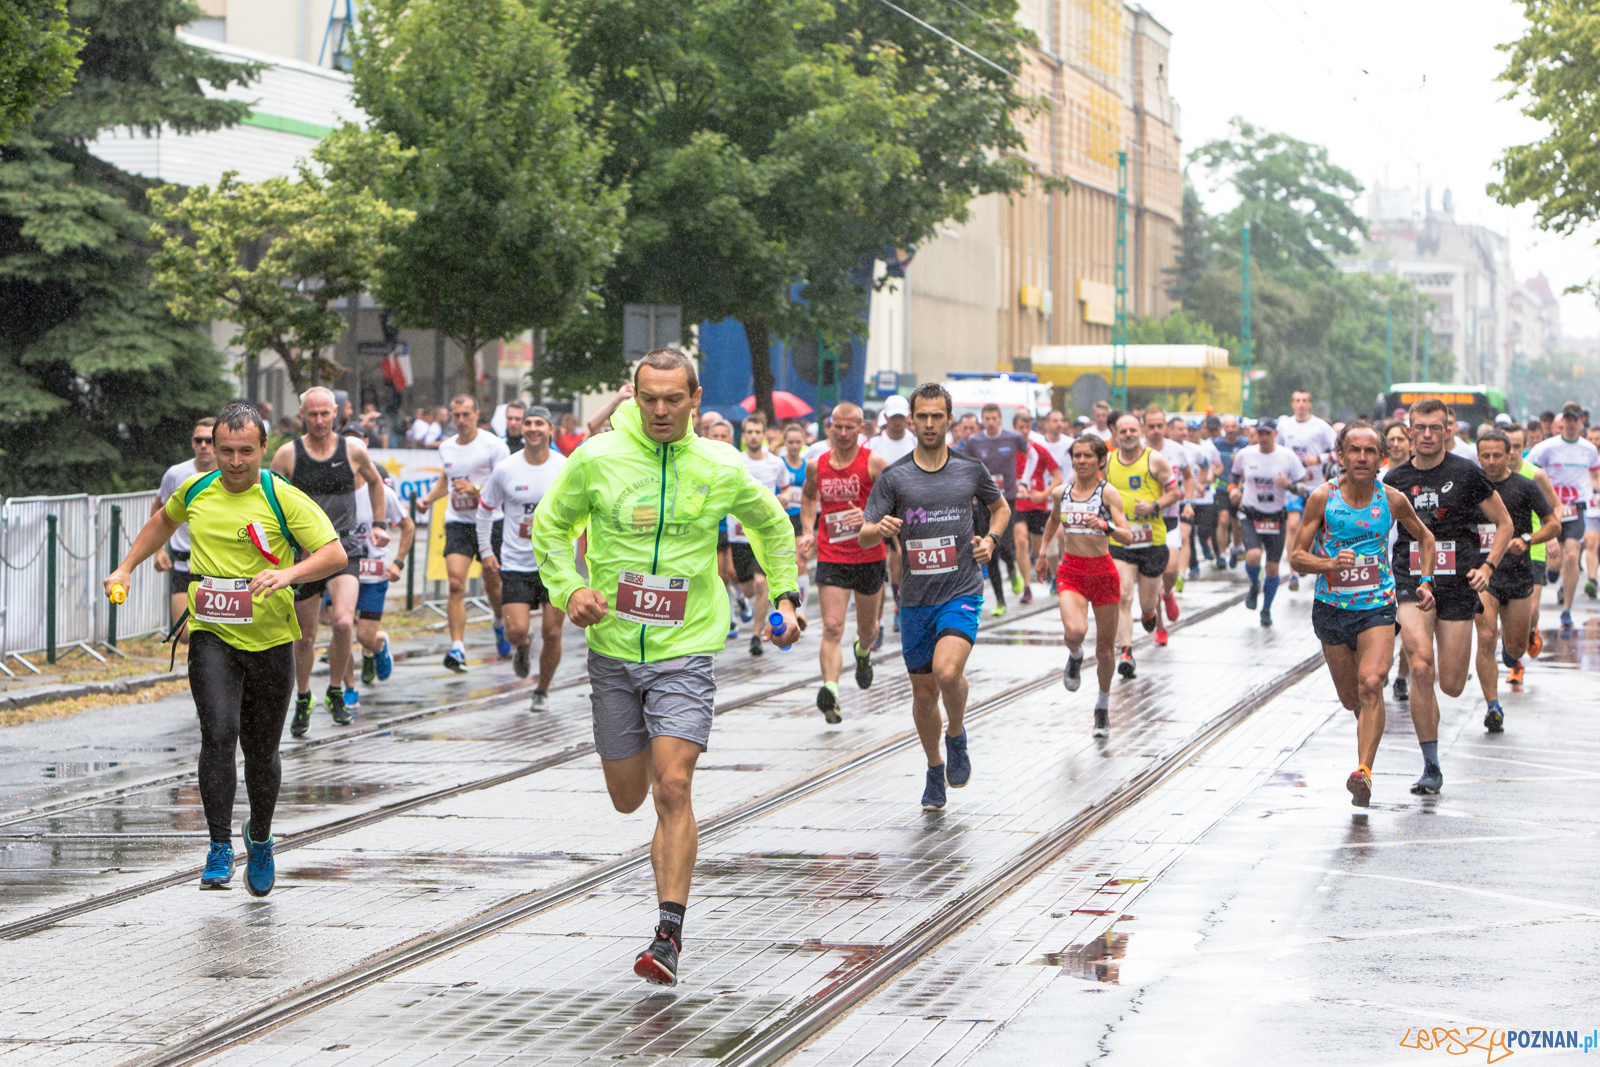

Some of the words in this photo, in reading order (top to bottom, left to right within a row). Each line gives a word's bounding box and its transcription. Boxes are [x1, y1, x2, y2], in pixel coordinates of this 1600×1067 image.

[632, 476, 660, 490] BIEGAJ
[917, 549, 947, 565] 841
[1340, 567, 1370, 582] 956
[204, 592, 240, 611] 20/1
[632, 589, 671, 613] 19/1
